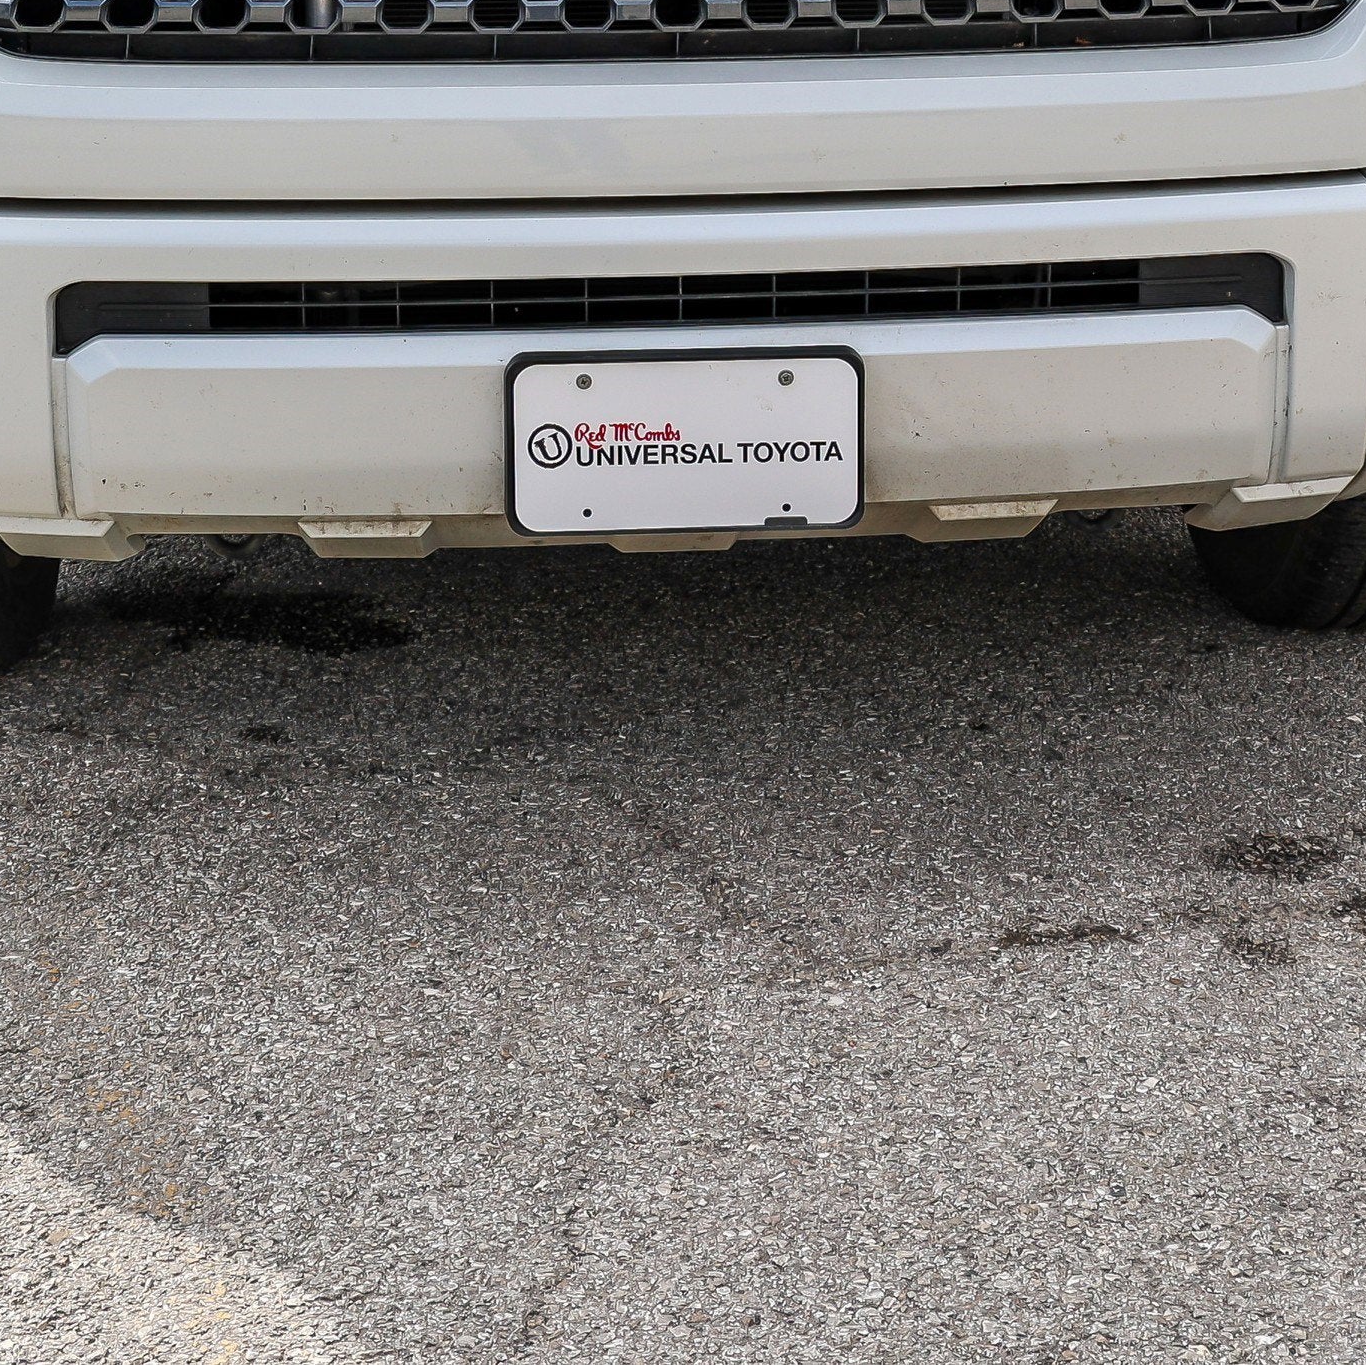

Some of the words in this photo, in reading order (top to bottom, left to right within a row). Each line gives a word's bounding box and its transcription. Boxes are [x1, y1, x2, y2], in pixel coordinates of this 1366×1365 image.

[575, 422, 606, 449] Red
[609, 422, 681, 442] McCombs
[576, 442, 733, 467] UNIVERSAL
[737, 441, 844, 464] TOYOTA
